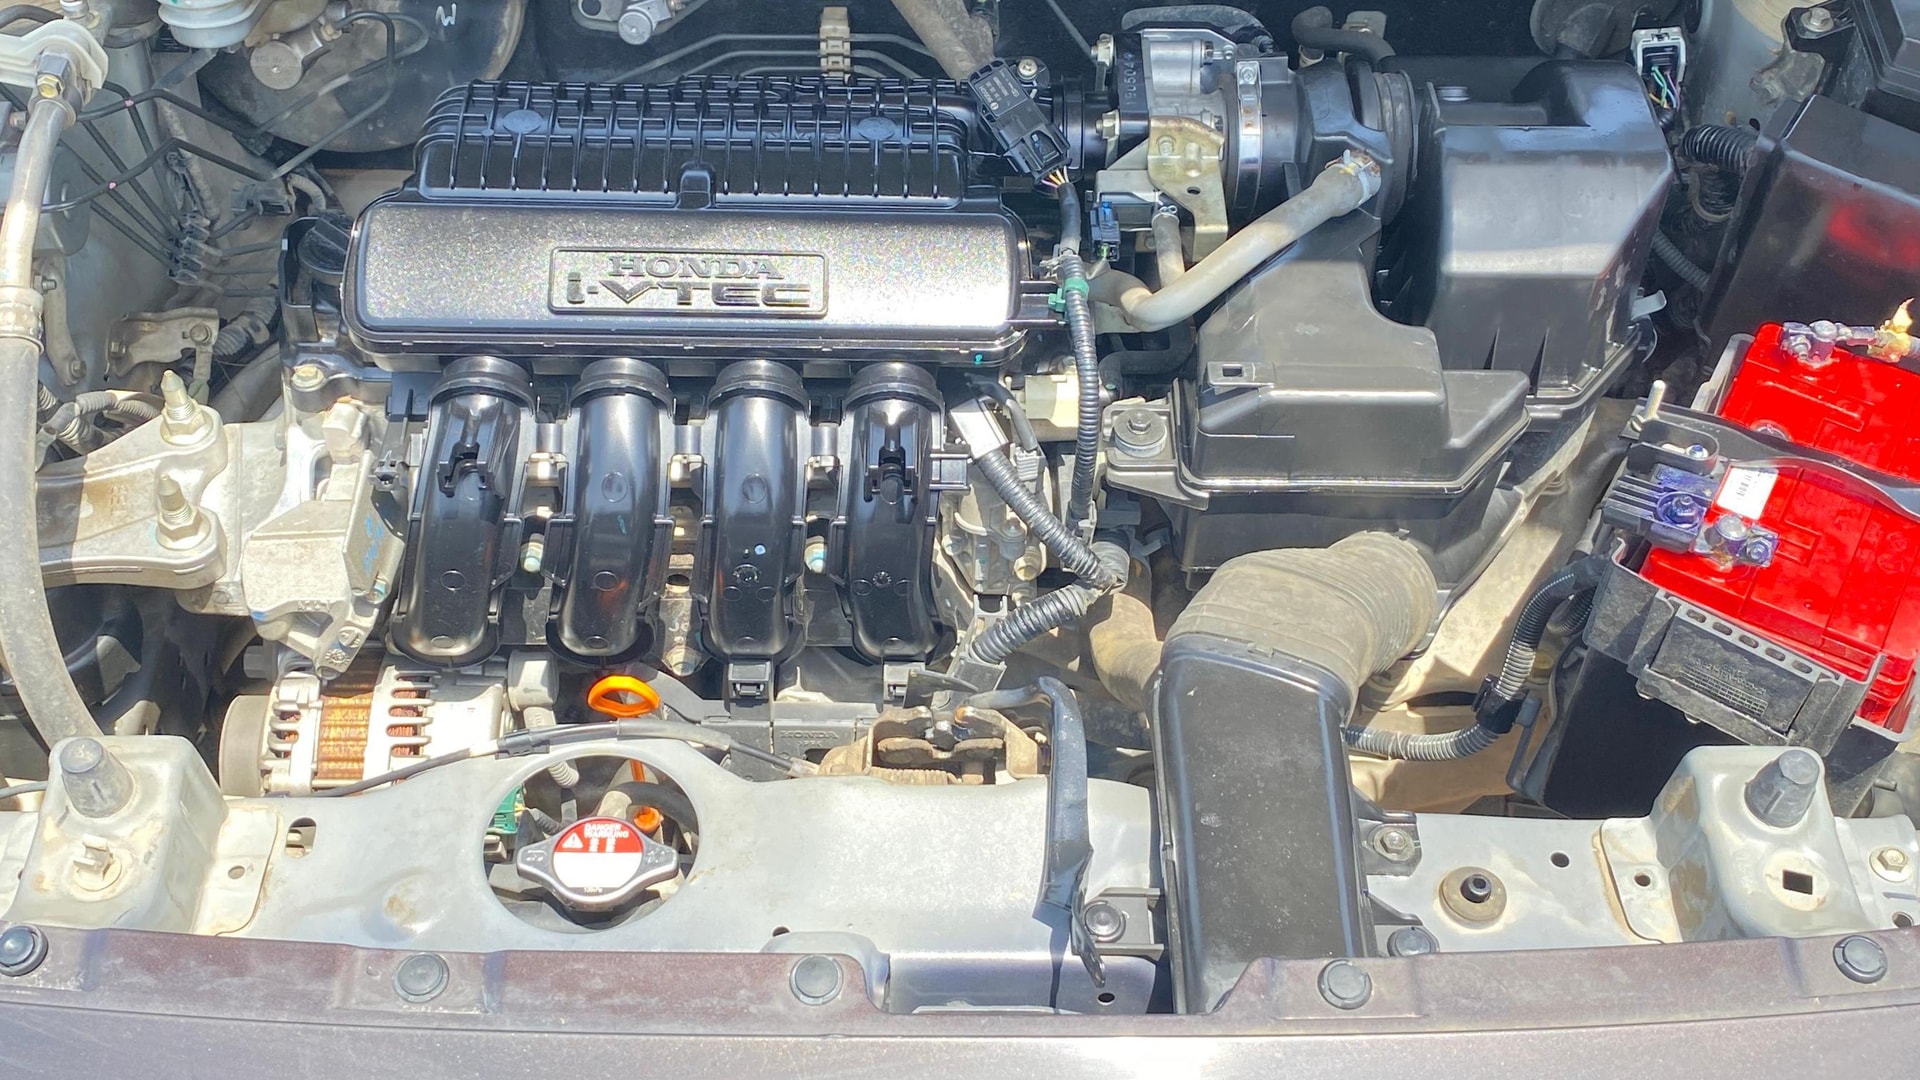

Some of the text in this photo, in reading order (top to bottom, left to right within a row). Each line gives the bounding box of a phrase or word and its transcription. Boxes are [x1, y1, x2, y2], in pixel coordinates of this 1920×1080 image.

[608, 256, 784, 280] HONDA
[566, 271, 811, 307] i-VTEC
[780, 730, 839, 740] HONDA
[584, 823, 622, 831] DANGER
